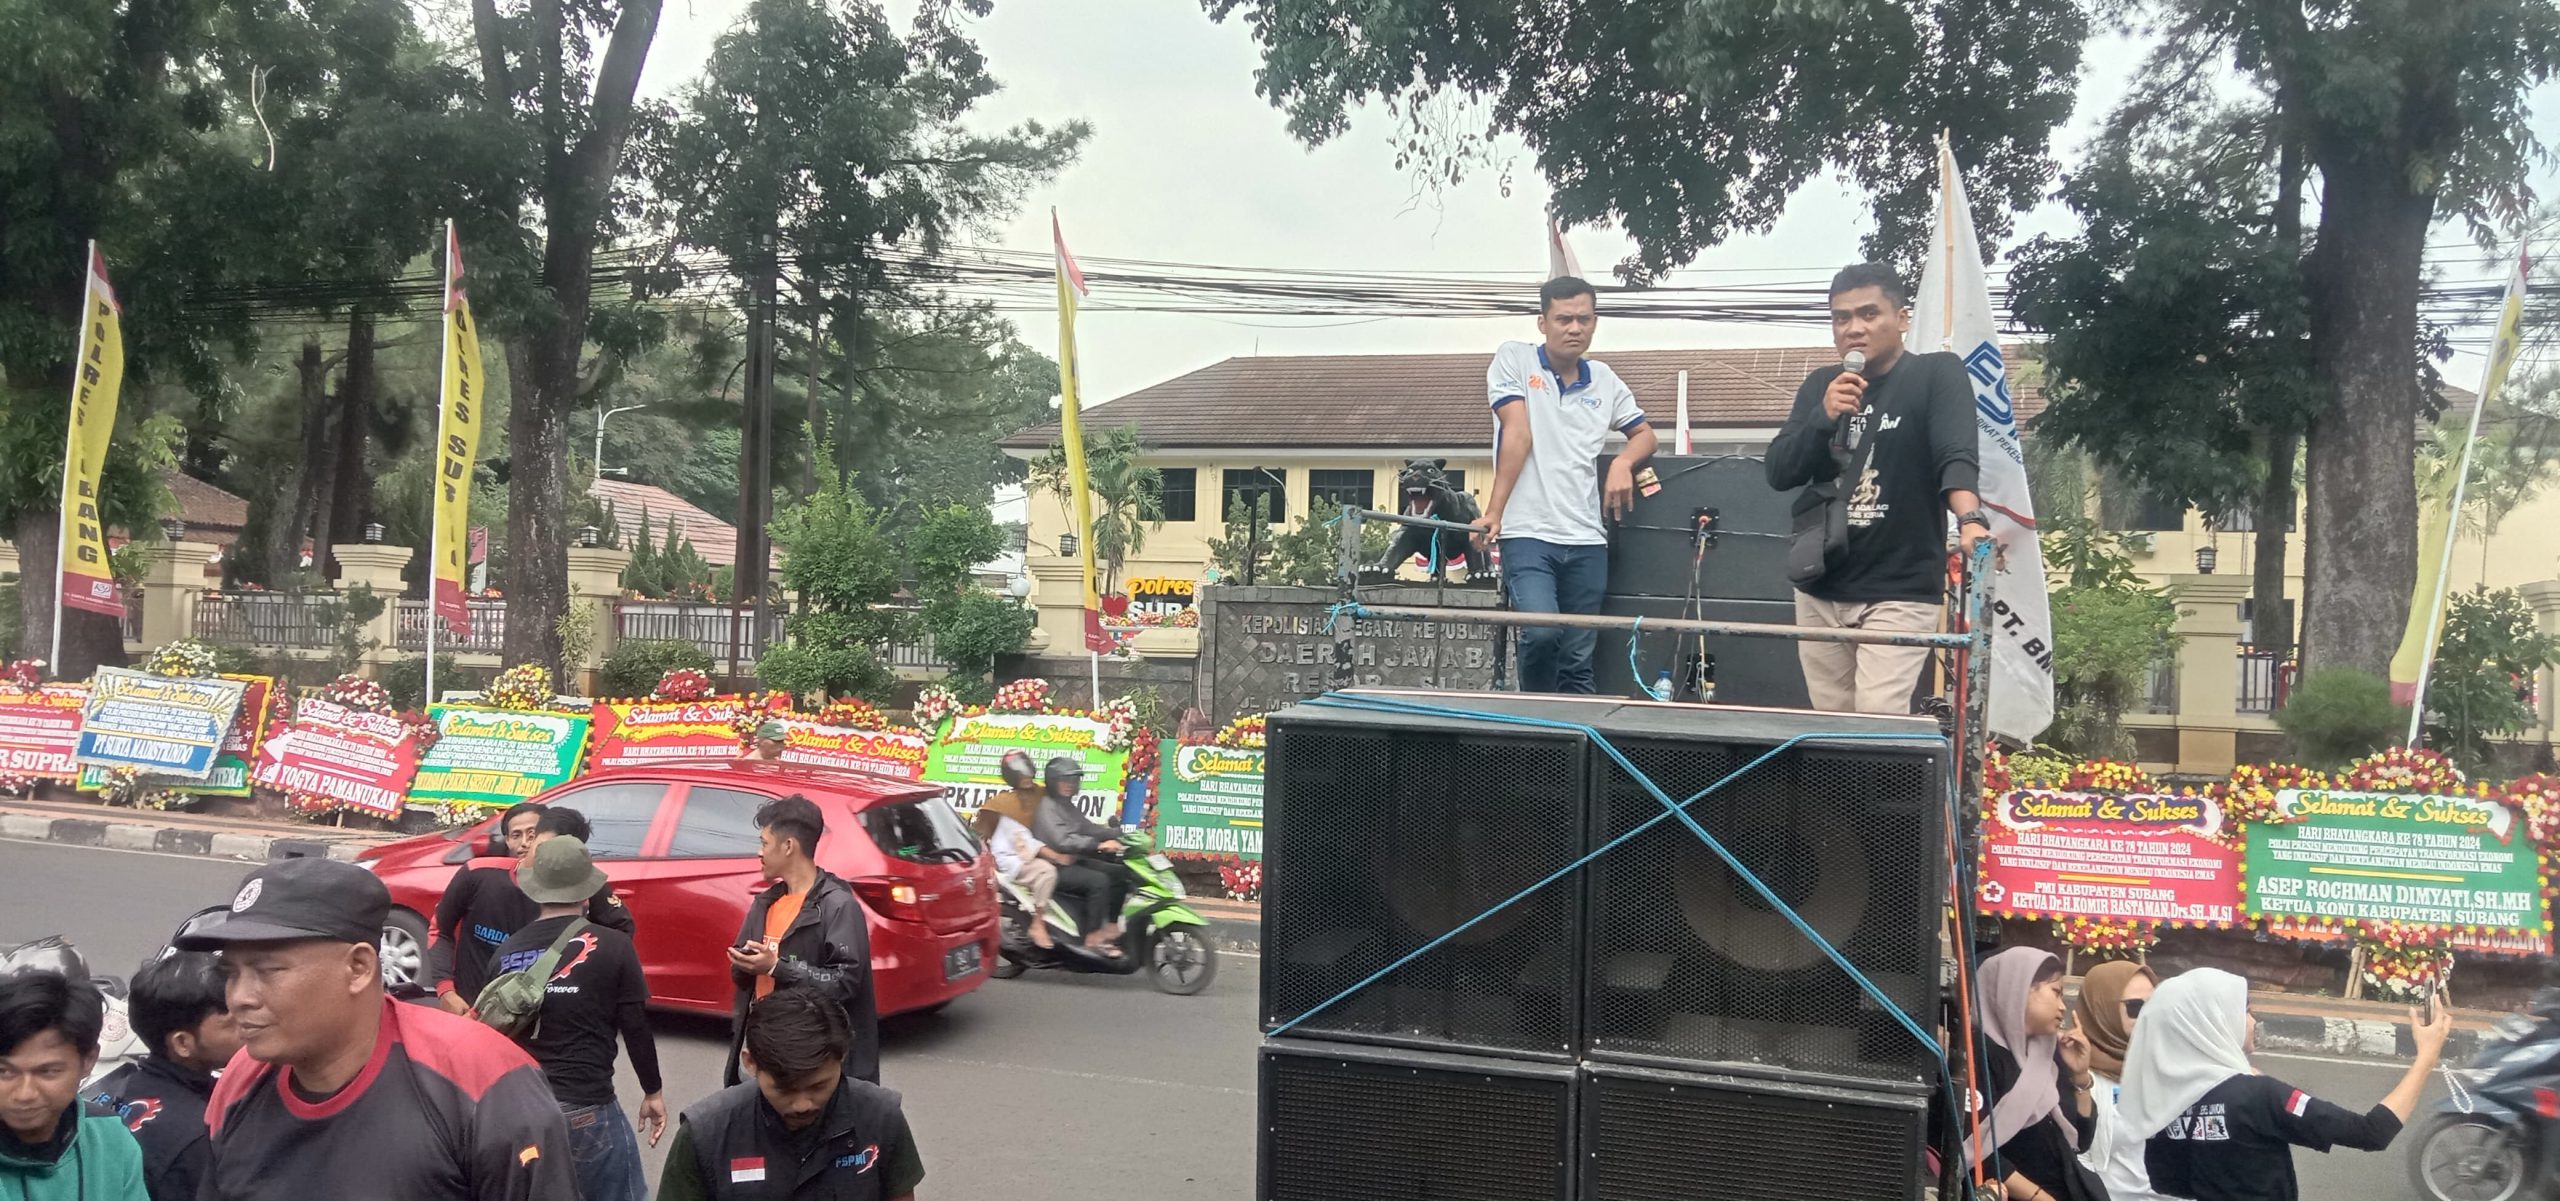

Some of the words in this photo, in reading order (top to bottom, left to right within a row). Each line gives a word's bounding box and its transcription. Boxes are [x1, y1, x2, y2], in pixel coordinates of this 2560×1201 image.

[453, 308, 469, 425] OLRES
[1126, 576, 1194, 598] Polres
[1241, 615, 1333, 636] KEPOLISIAN
[1354, 619, 1404, 639] EGARA
[1259, 642, 1376, 667] DAERH
[626, 706, 680, 725] Selamat
[683, 706, 704, 722] &
[703, 705, 735, 722] Suk
[784, 726, 843, 750] Selamat
[845, 735, 868, 753] &
[867, 738, 921, 761] Sukses
[961, 721, 1016, 740] Selamat
[1019, 722, 1040, 741] &
[1040, 724, 1092, 744] Sukses
[1192, 753, 1253, 772] Selamat
[279, 765, 320, 793] YOGYA
[318, 775, 400, 812] PAMANUKAN
[1200, 780, 1218, 792] HARI
[1218, 781, 1264, 796] BHAYANGKA
[2015, 796, 2093, 819] Selamat
[2096, 797, 2126, 820] &
[2128, 797, 2199, 822] Sukses
[2293, 792, 2376, 818] Selamat
[2379, 795, 2411, 819] &
[2415, 800, 2489, 825] Sukses
[1165, 825, 1204, 850] DELER
[1206, 827, 1239, 852] MORA
[1240, 829, 1263, 854] YAM
[2017, 832, 2041, 846] HARI
[2041, 833, 2109, 851] BHAYANGKARA
[2110, 839, 2124, 852] KE
[2125, 840, 2136, 853] 78
[2136, 841, 2168, 855] TAHUN
[2170, 842, 2191, 855] 2024
[2268, 838, 2291, 849] POLRI
[2298, 825, 2322, 839] HARI
[2323, 827, 2395, 845] BHAYANGKARA
[2396, 832, 2411, 845] KE
[2412, 833, 2423, 846] 78
[2424, 834, 2458, 848] TAHUN
[2459, 836, 2480, 850] 2024
[2480, 863, 2502, 874] EMAS
[2012, 891, 2048, 910] KETUA
[2034, 881, 2057, 895] PMI
[2058, 883, 2126, 899] KABUPATEN
[2128, 887, 2175, 901] SUBANG
[2256, 876, 2303, 896] ASEP
[2306, 879, 2393, 903] ROCHMAN
[2260, 896, 2313, 913] KETUA
[2316, 901, 2355, 916] KONI
[2357, 903, 2452, 923] KABUPATEN
[2455, 909, 2520, 926] SUBANG
